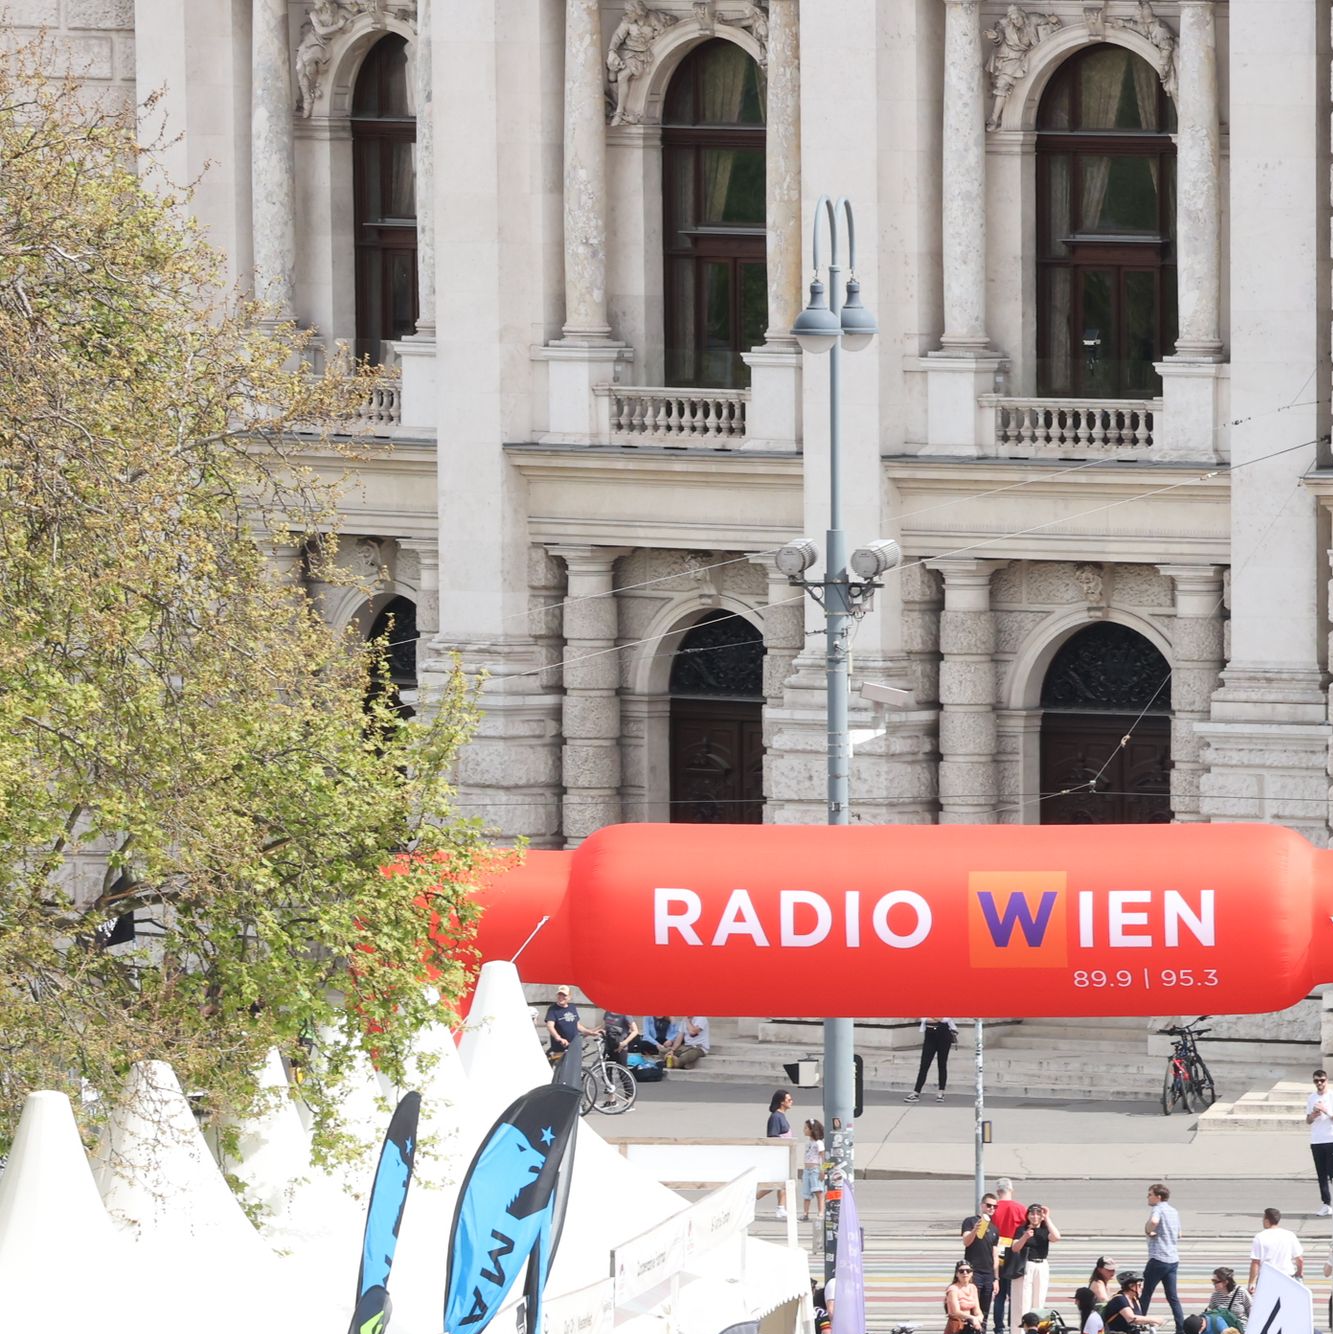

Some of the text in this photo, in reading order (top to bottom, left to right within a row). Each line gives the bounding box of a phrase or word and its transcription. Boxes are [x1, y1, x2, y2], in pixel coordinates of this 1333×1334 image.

[654, 887, 1216, 949] RADIO WIEN
[1073, 968, 1133, 989] 89.9
[1161, 968, 1219, 989] 95.3
